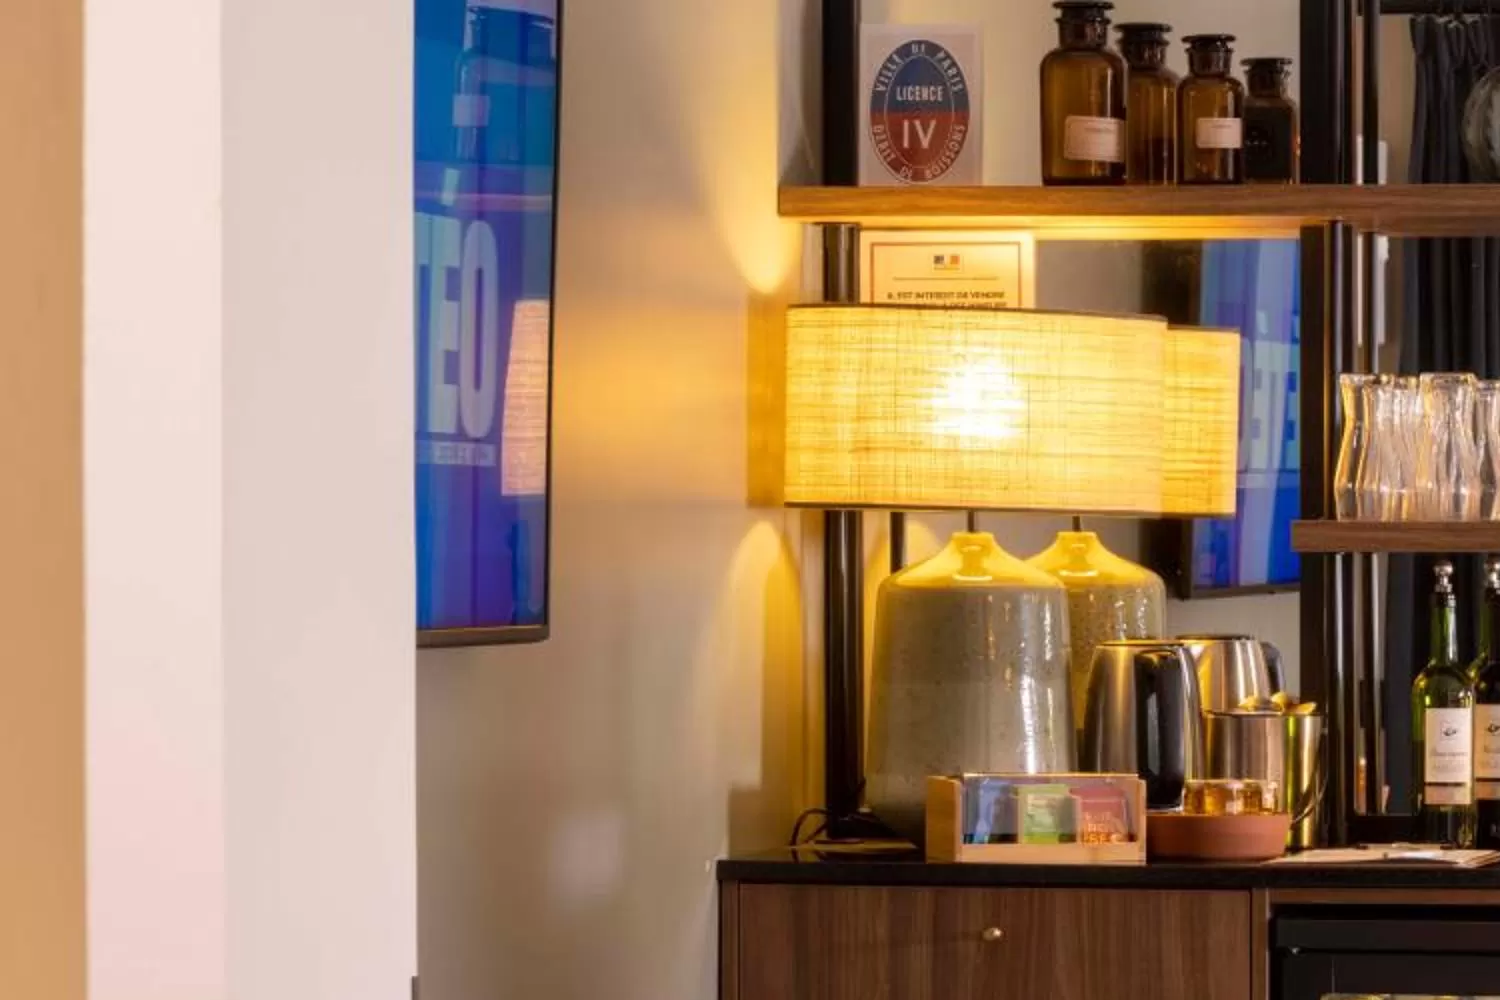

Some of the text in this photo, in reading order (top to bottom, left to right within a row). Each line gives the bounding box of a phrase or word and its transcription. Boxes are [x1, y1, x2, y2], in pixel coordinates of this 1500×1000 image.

[876, 53, 904, 92] VILLE
[935, 50, 965, 92] PARIS
[896, 85, 943, 102] LICENCE
[902, 119, 937, 149] IV
